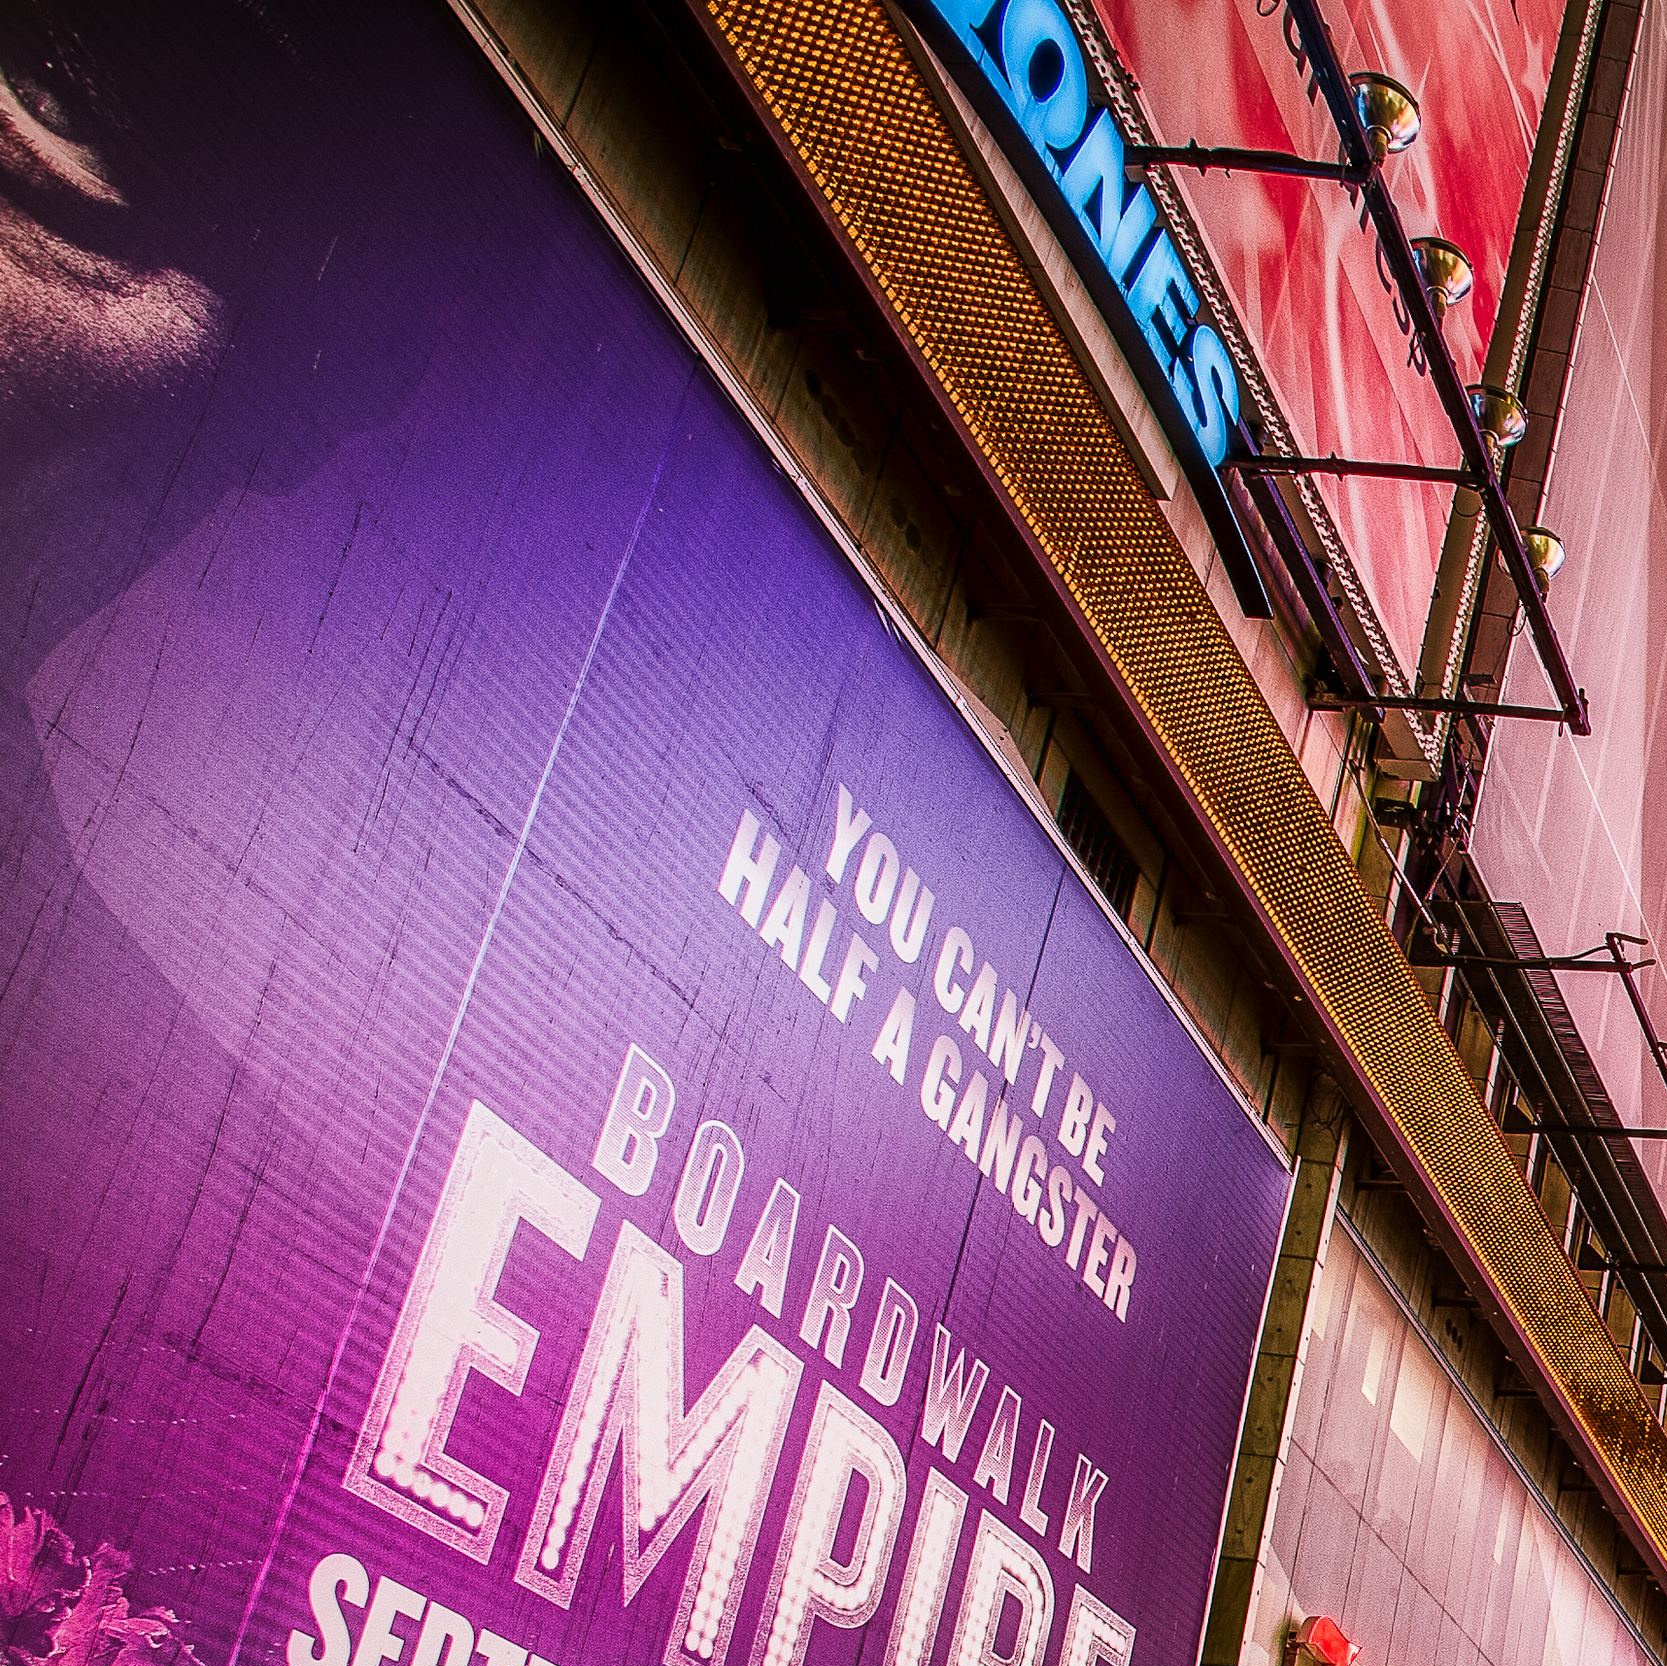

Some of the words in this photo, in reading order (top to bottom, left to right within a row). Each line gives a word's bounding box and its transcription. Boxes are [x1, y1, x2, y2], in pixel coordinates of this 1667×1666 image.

[718, 809, 878, 1019] HALF
[870, 986, 918, 1085] A
[919, 1034, 1136, 1324] GANGSTER
[822, 784, 936, 963] YOU
[933, 925, 1068, 1118] CAN'T
[1061, 1070, 1117, 1189] BE
[593, 1045, 1107, 1575] BOARDWALK
